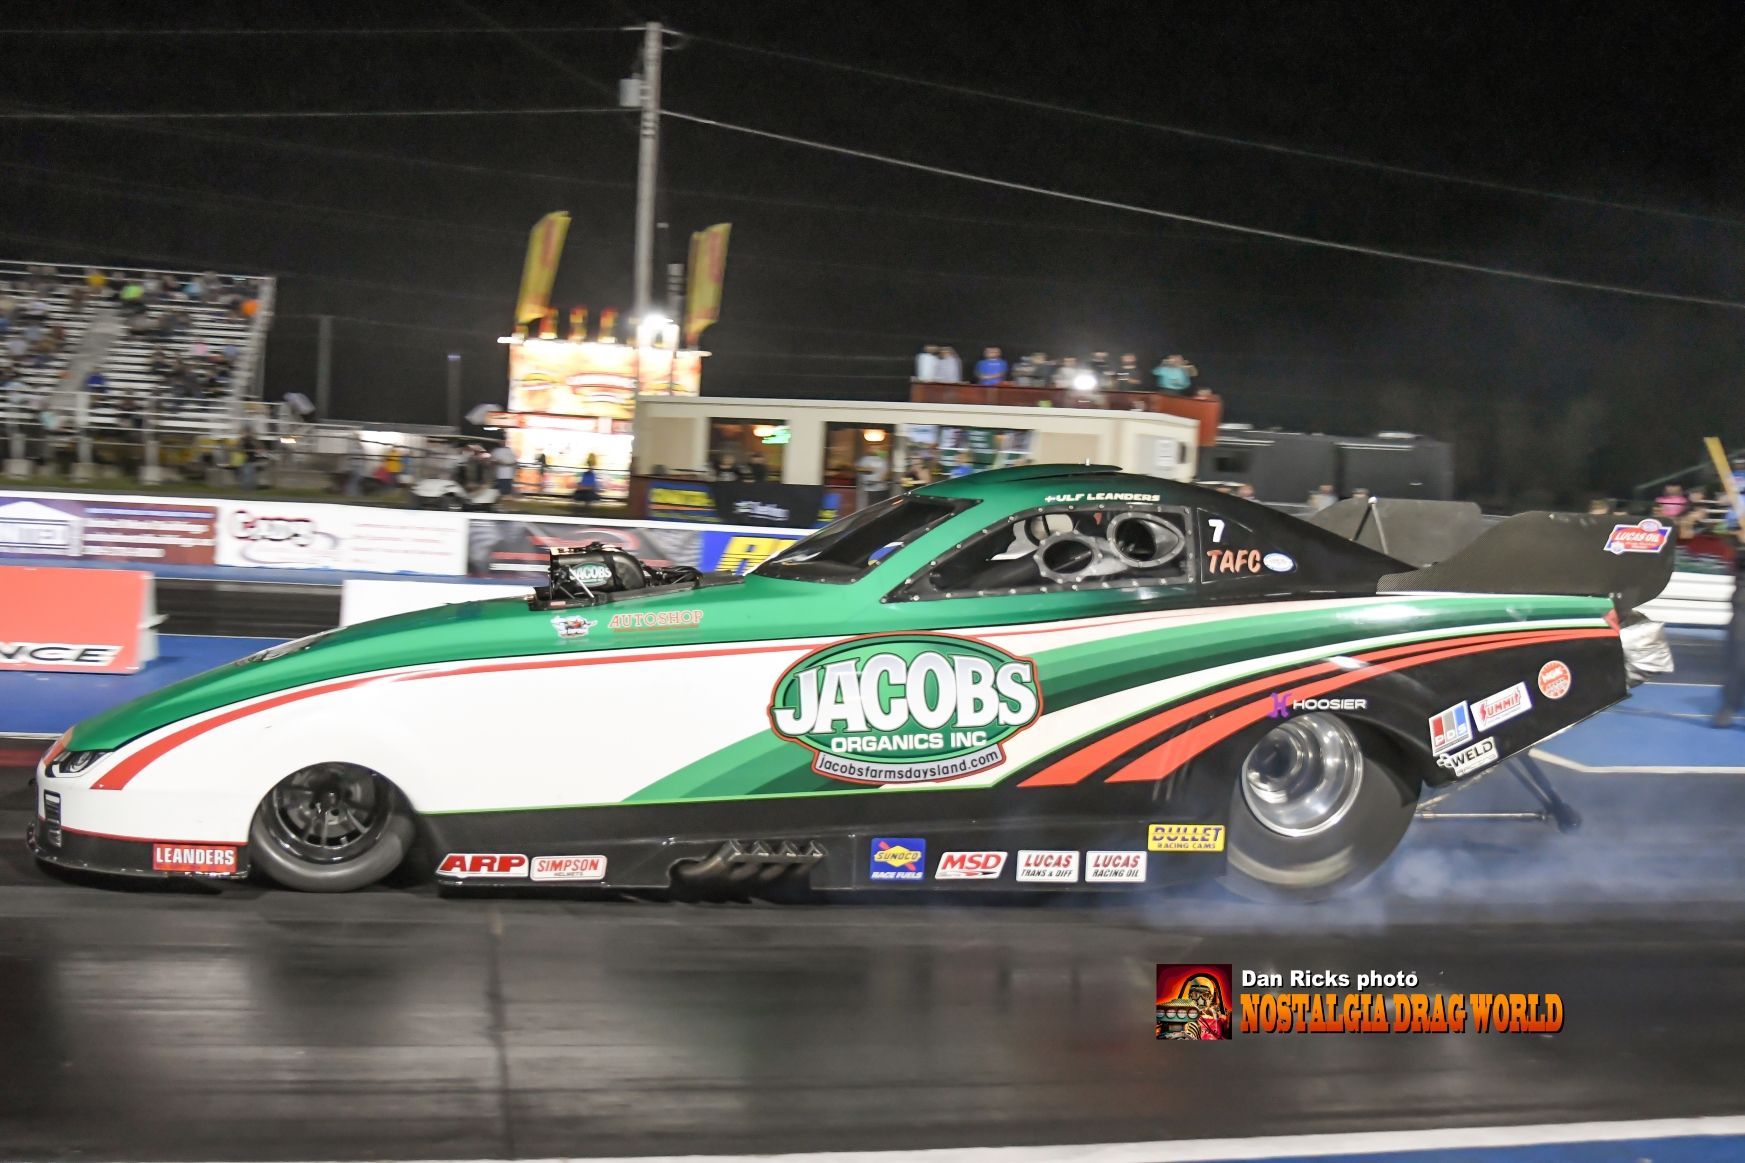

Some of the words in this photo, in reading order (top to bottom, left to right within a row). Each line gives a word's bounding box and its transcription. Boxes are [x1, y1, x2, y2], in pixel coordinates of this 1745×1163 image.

[1055, 493, 1085, 502] ULF
[1086, 492, 1160, 502] LEANDERS
[1208, 518, 1225, 543] 7
[1615, 531, 1645, 541] LUCAS
[1206, 549, 1261, 574] TAFC
[607, 609, 704, 628] AUTOSHOP
[773, 650, 1039, 736] JACOBS
[1293, 698, 1368, 710] HOOSIER
[1479, 689, 1522, 725] SUMMIT
[831, 733, 945, 753] ORGANICS
[950, 730, 988, 748] INC
[1451, 740, 1494, 768] WELD
[817, 750, 1000, 780] jacobsfarmsdaysland.com
[1152, 826, 1223, 842] BULLET
[156, 847, 235, 865] LEANDERS
[439, 855, 526, 873] ARP
[877, 852, 920, 861] SUNOCO
[941, 853, 1002, 870] MSD
[1024, 854, 1073, 868] LUCAS
[1093, 855, 1141, 868] LUCAS
[537, 858, 600, 873] SIMPSON
[1021, 869, 1047, 877] TRANS
[1055, 869, 1073, 877] DIFF
[1092, 869, 1125, 877] RACING
[1126, 869, 1139, 877] OIL
[871, 871, 897, 880] RACE
[897, 871, 924, 880] FUELS
